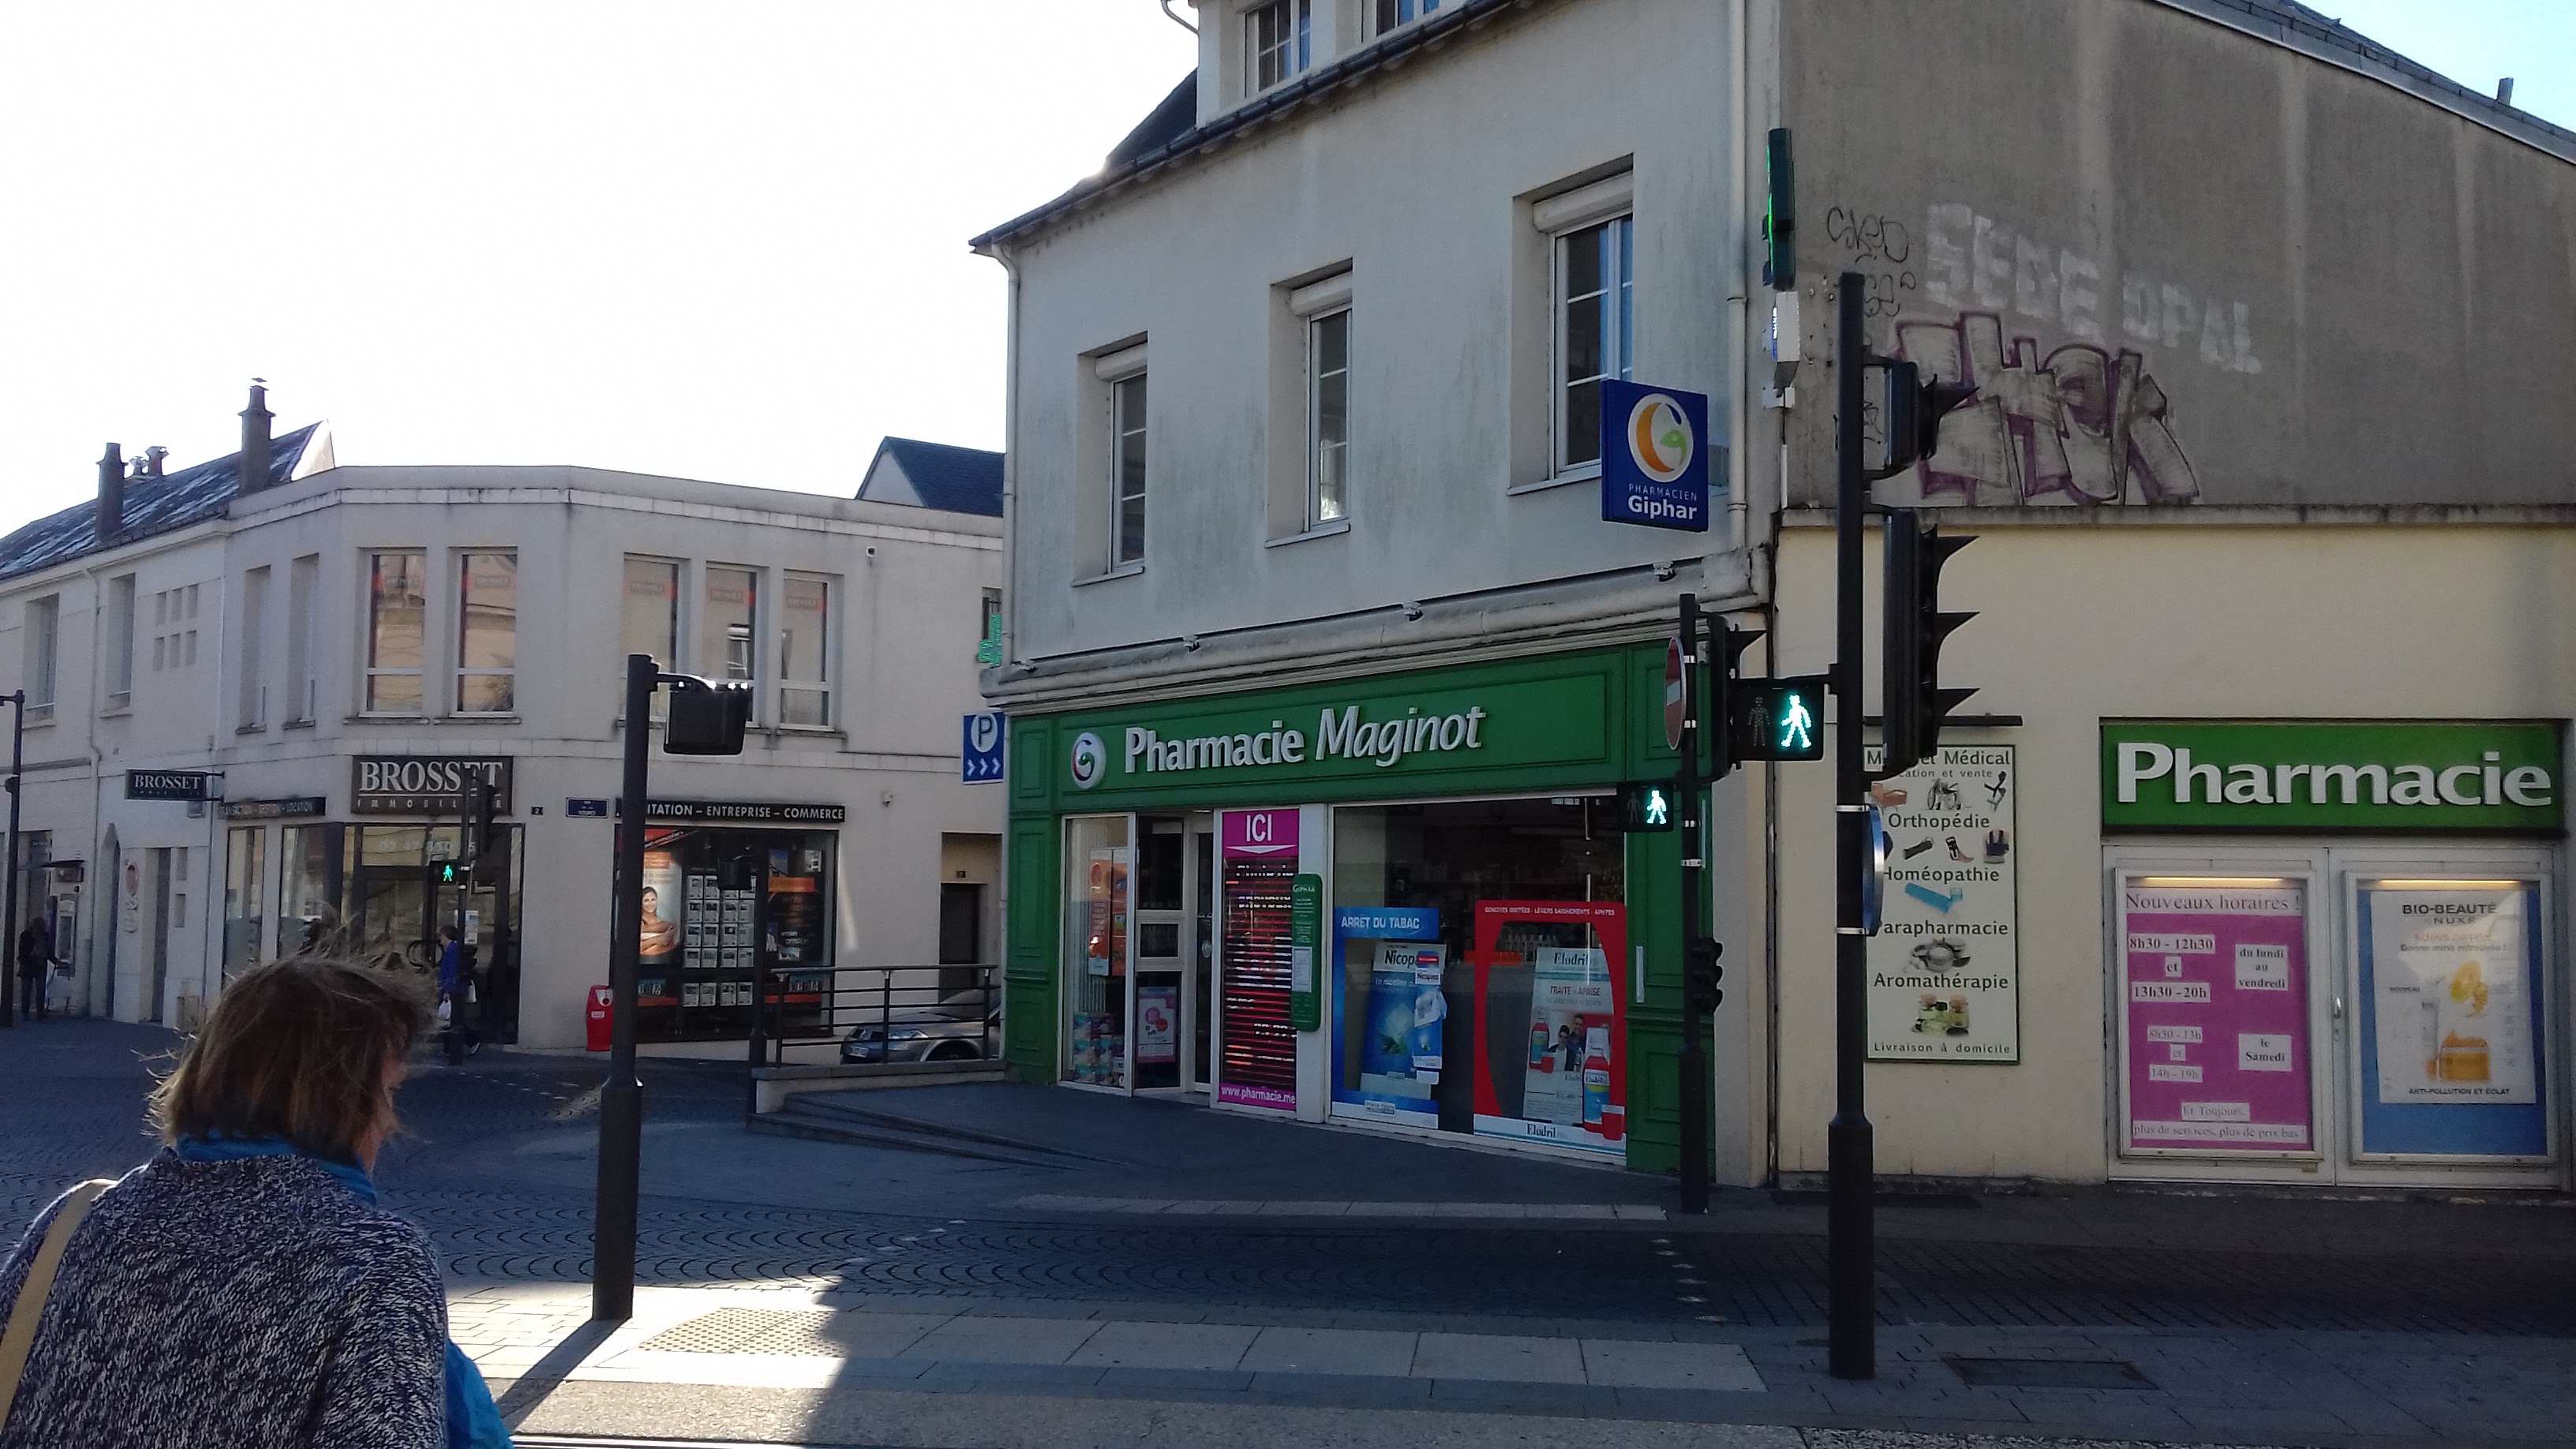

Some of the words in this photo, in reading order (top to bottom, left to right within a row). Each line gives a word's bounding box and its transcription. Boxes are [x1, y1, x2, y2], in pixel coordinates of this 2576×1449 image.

[1628, 483, 1697, 501] PHARMACIEN
[1628, 495, 1697, 519] Giphar
[977, 715, 993, 748] P
[1125, 720, 1305, 773] Pharmacie
[1315, 705, 1486, 767] Maginot
[1944, 749, 2010, 765] Médical
[1899, 769, 1934, 777] cation
[2117, 742, 2552, 807] Pharmacie
[135, 774, 201, 790] BROSSET
[358, 799, 502, 809] IMMOBILR
[646, 803, 693, 816] ITATION
[706, 805, 771, 818] ENTREPRISE
[784, 807, 844, 820] COMMERCE
[1245, 813, 1273, 842] ICI
[1889, 813, 1990, 831] Orthopédie
[2126, 893, 2214, 909] Nouveaux
[2219, 894, 2288, 910] horaires
[2402, 901, 2498, 914] BIO-BEAUTÉ
[1373, 916, 1386, 928] DU
[1389, 916, 1420, 930] TABAC
[1884, 919, 2008, 938] arapharmacie
[2130, 938, 2161, 949] 8h30
[2175, 938, 2213, 949] 12h30
[2240, 949, 2252, 957] du
[2256, 948, 2284, 958] lundi
[2166, 962, 2178, 972] et
[1874, 972, 2009, 992] Aromathérapie
[2239, 978, 2286, 988] vendredi
[2135, 987, 2172, 998] 13h30
[2184, 987, 2207, 998] 20h
[1874, 1042, 1933, 1052] Livraison
[1941, 1042, 1948, 1053] à
[1956, 1043, 2010, 1054] domicile
[2260, 1038, 2270, 1048] le
[2245, 1051, 2285, 1062] Samedi
[2133, 1125, 2155, 1136] plus
[2158, 1125, 2170, 1135] de
[2219, 1126, 2240, 1138] plus
[2243, 1127, 2256, 1137] de
